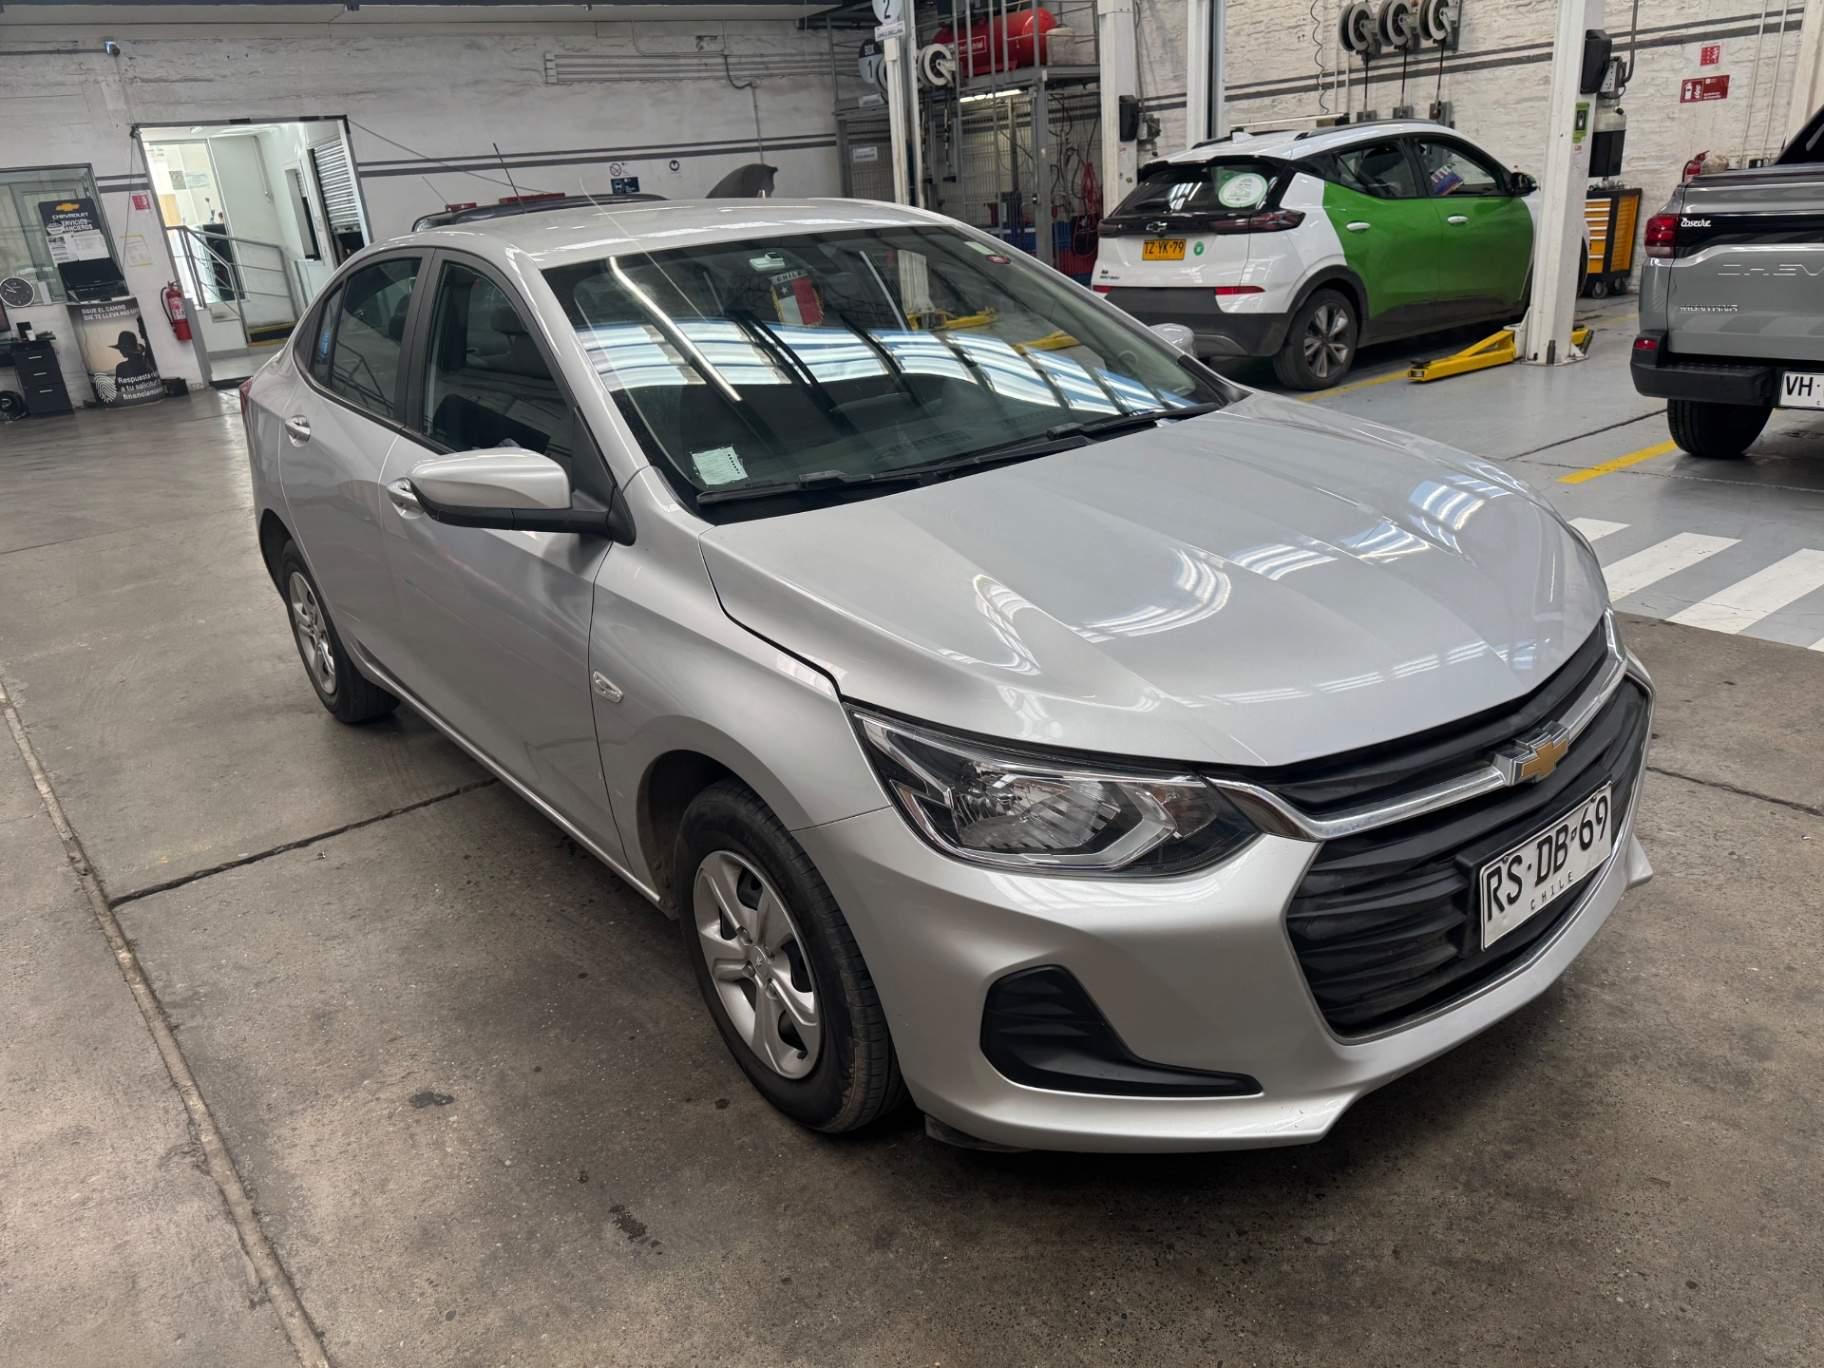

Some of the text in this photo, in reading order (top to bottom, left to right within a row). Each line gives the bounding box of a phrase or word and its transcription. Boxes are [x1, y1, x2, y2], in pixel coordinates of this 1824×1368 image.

[883, 0, 891, 19] 2
[867, 60, 873, 78] 1
[1531, 872, 1573, 910] CHILE
